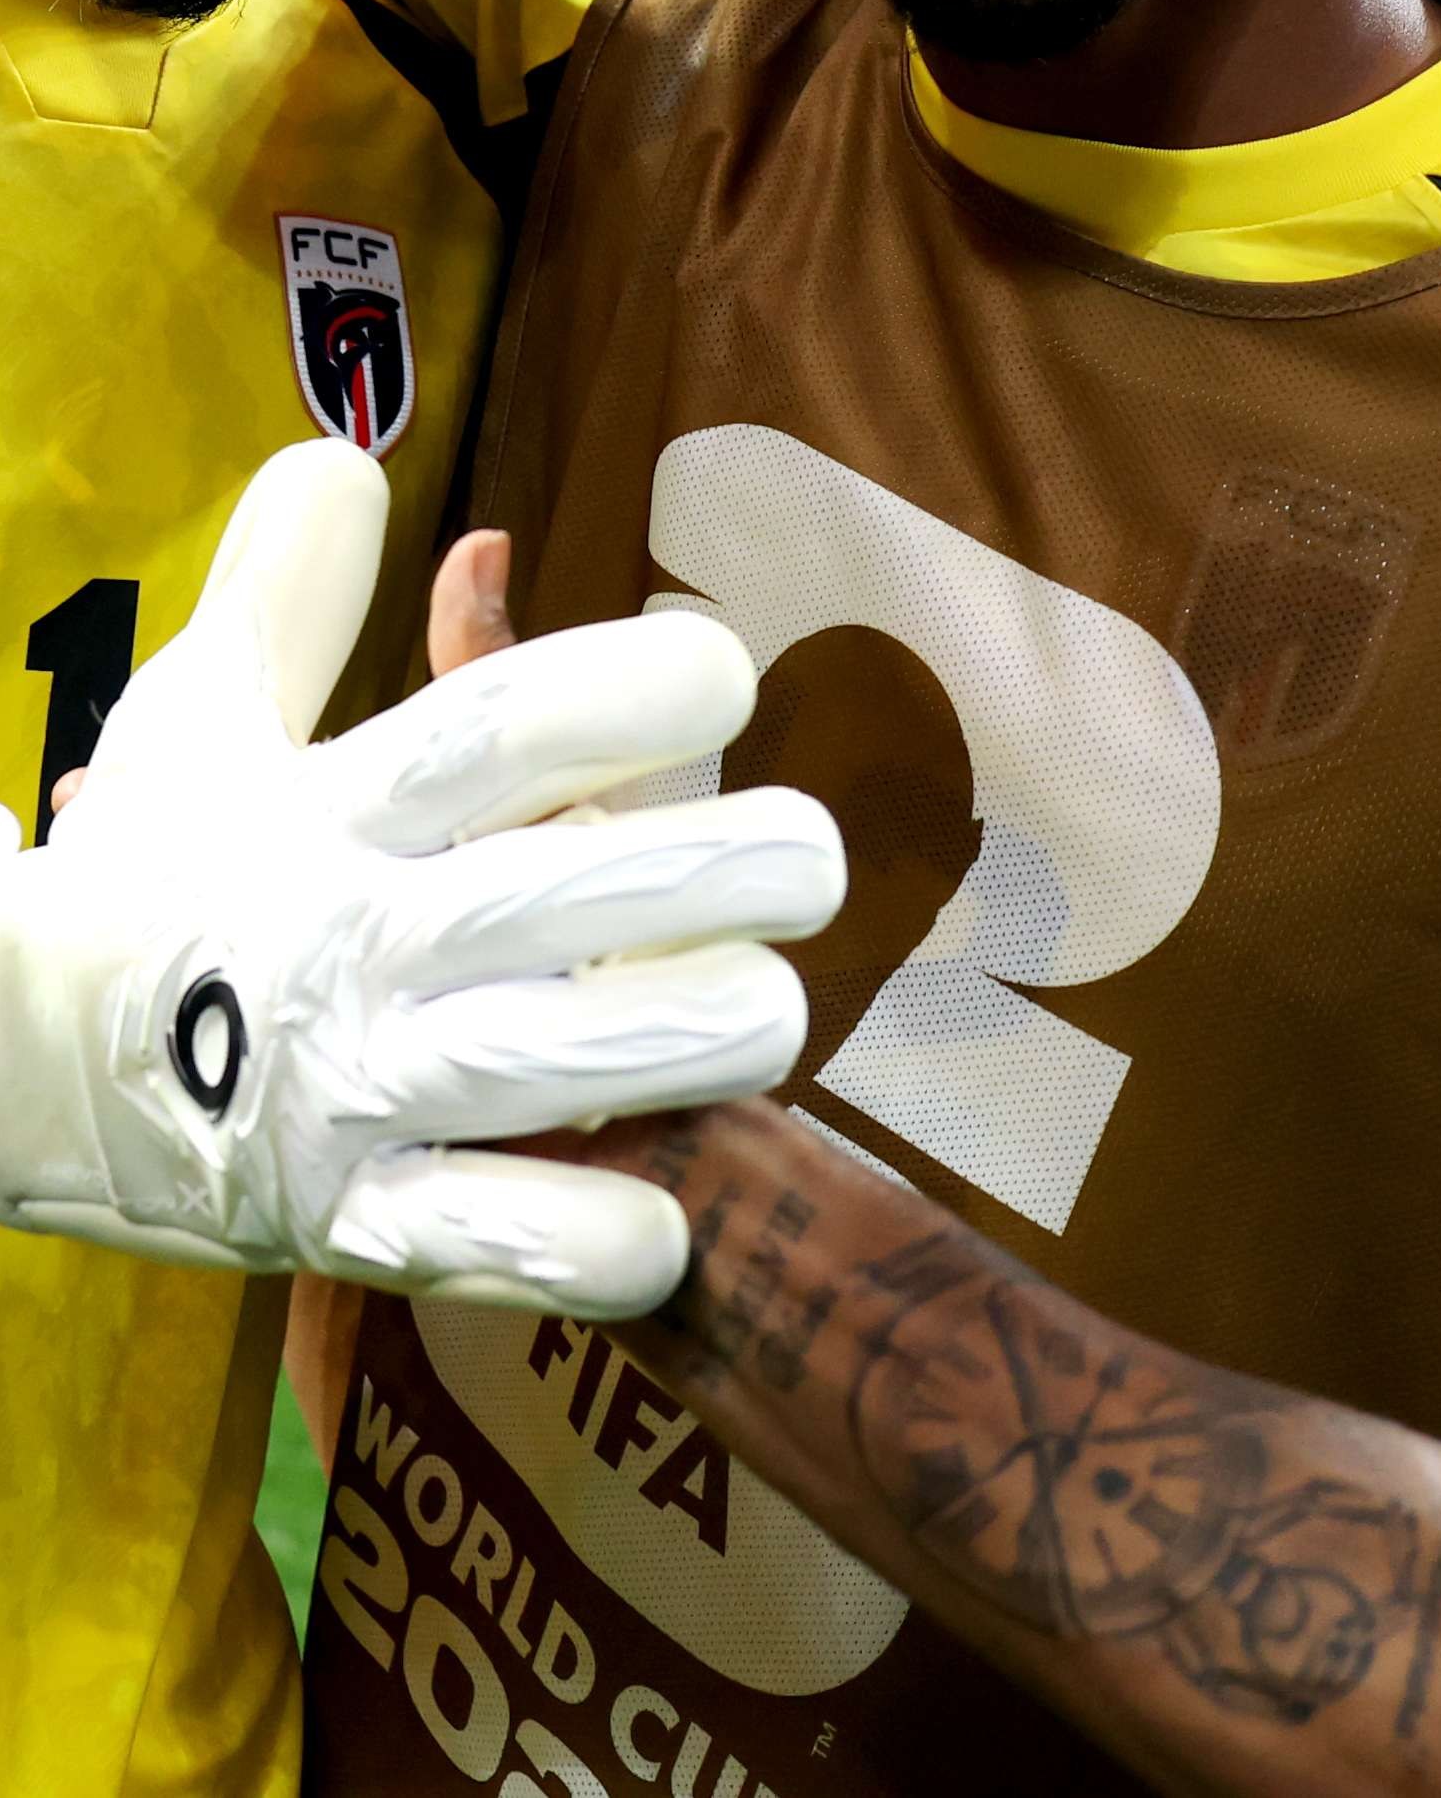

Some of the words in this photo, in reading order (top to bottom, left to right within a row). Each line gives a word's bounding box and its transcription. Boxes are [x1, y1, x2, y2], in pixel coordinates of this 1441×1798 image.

[291, 228, 389, 269] FCF
[527, 1314, 731, 1558] FIFA
[352, 1374, 596, 1704] WORLD
[609, 1684, 782, 1798] CU
